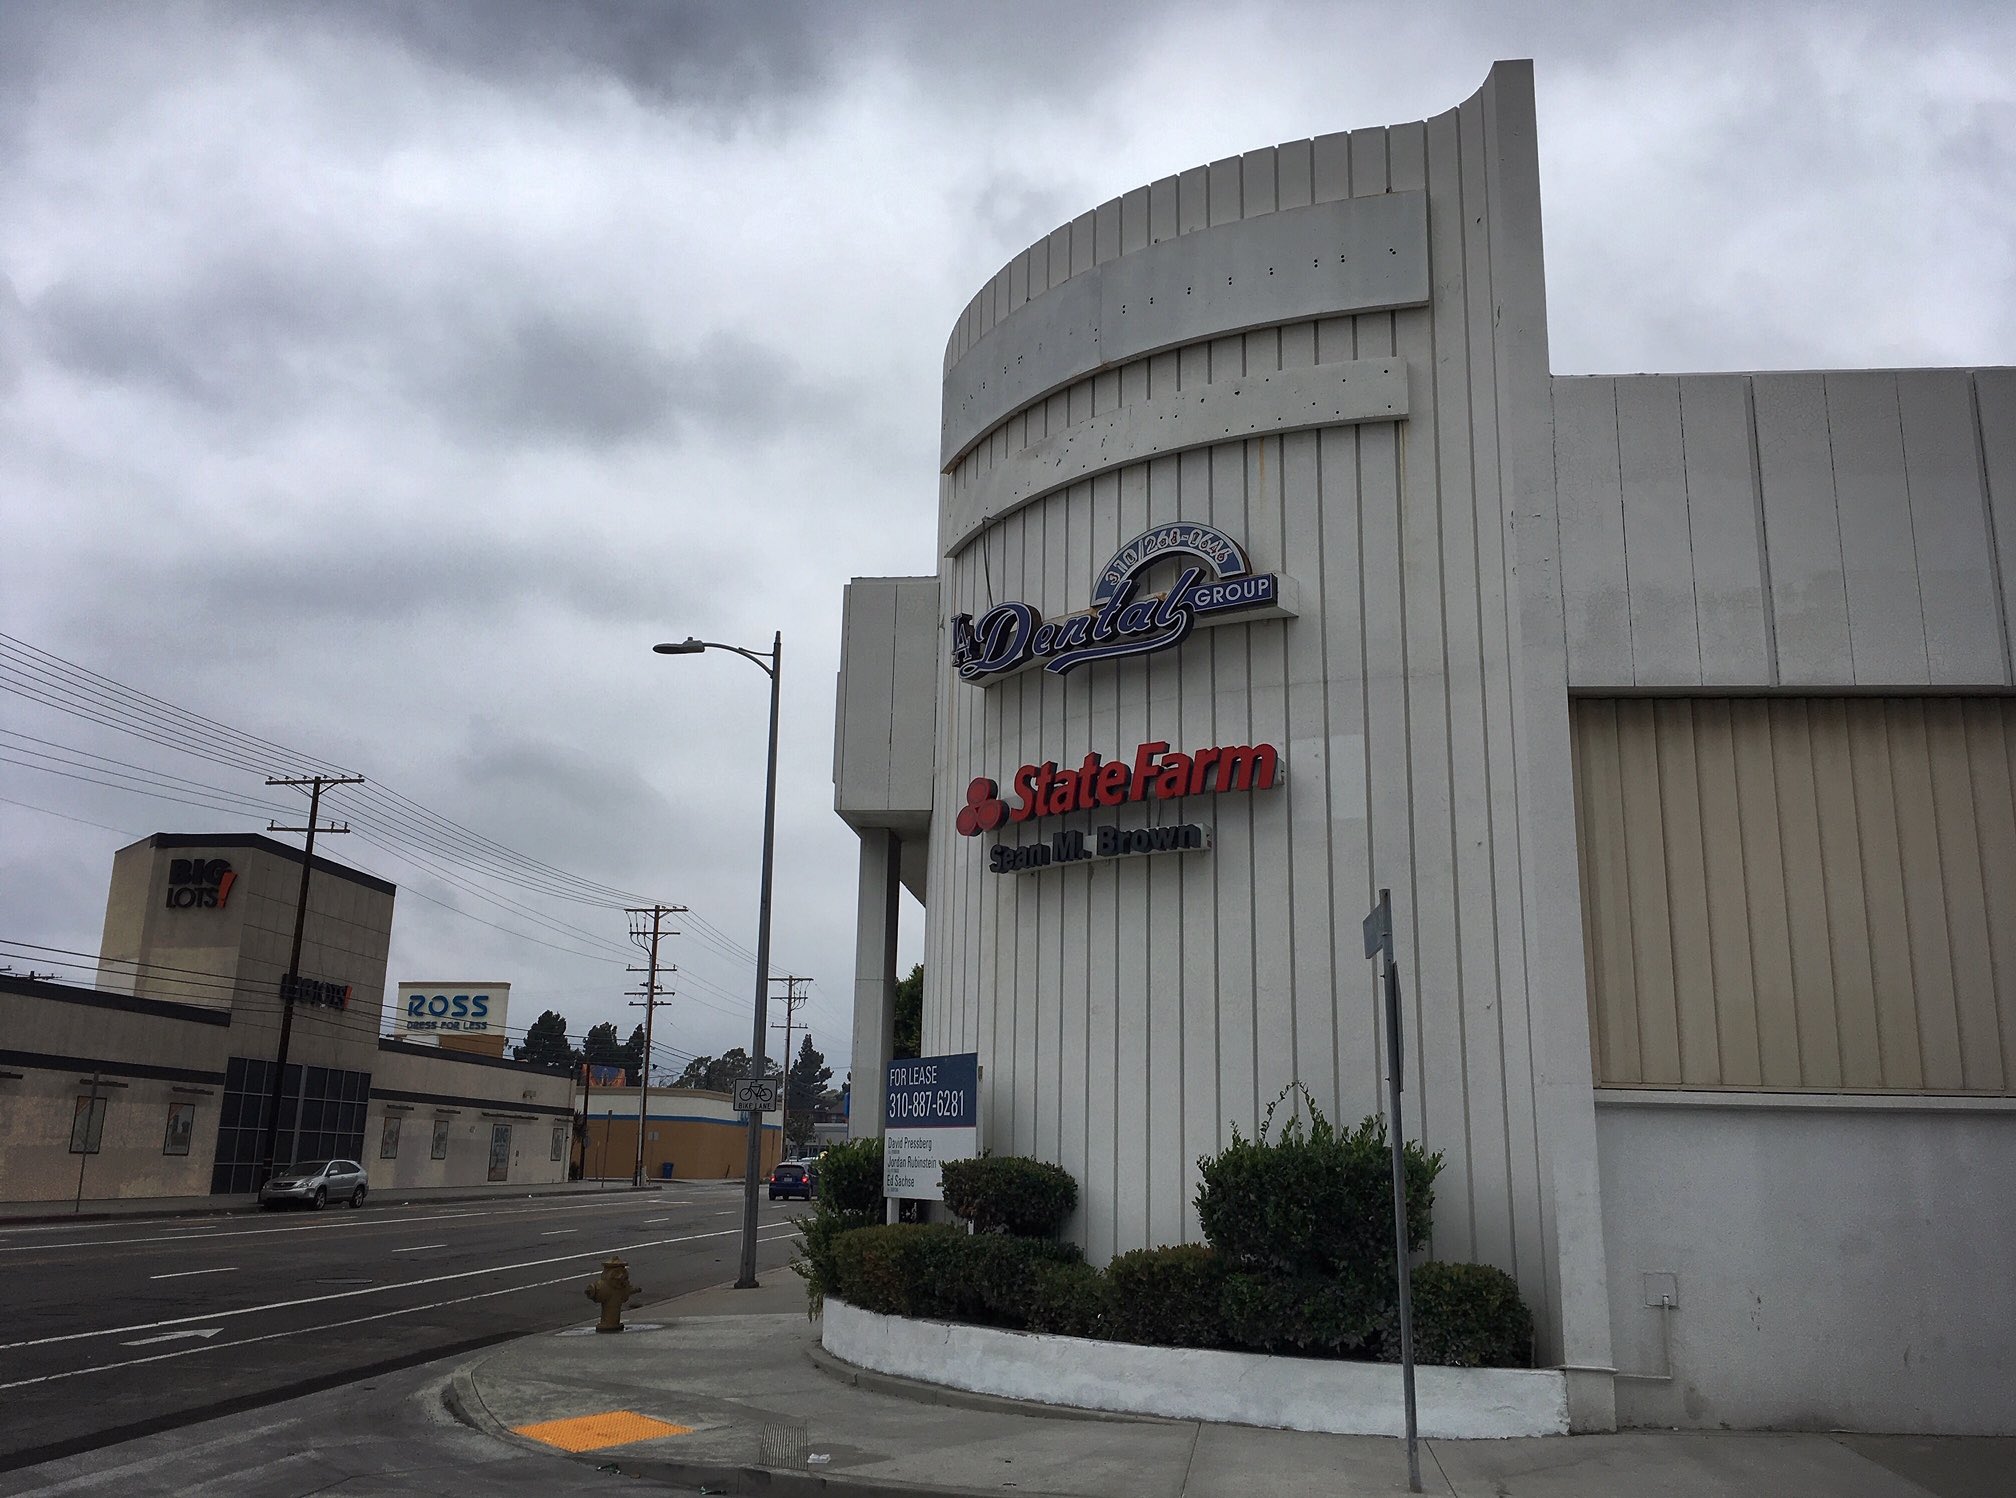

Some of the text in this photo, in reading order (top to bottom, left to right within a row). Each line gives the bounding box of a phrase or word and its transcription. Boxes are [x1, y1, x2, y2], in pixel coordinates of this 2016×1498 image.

[959, 565, 1200, 679] Dental
[1194, 577, 1271, 606] GROUP
[989, 823, 1204, 874] Sean M. Brown
[168, 858, 232, 886] BIG
[408, 995, 489, 1017] ROSS
[889, 1065, 938, 1087] FOR LEASE
[755, 1102, 771, 1110] LANE
[889, 1089, 964, 1118] 310-887-6281
[888, 1136, 903, 1149] David
[888, 1156, 906, 1168] Jordan
[887, 1174, 894, 1187] Ed
